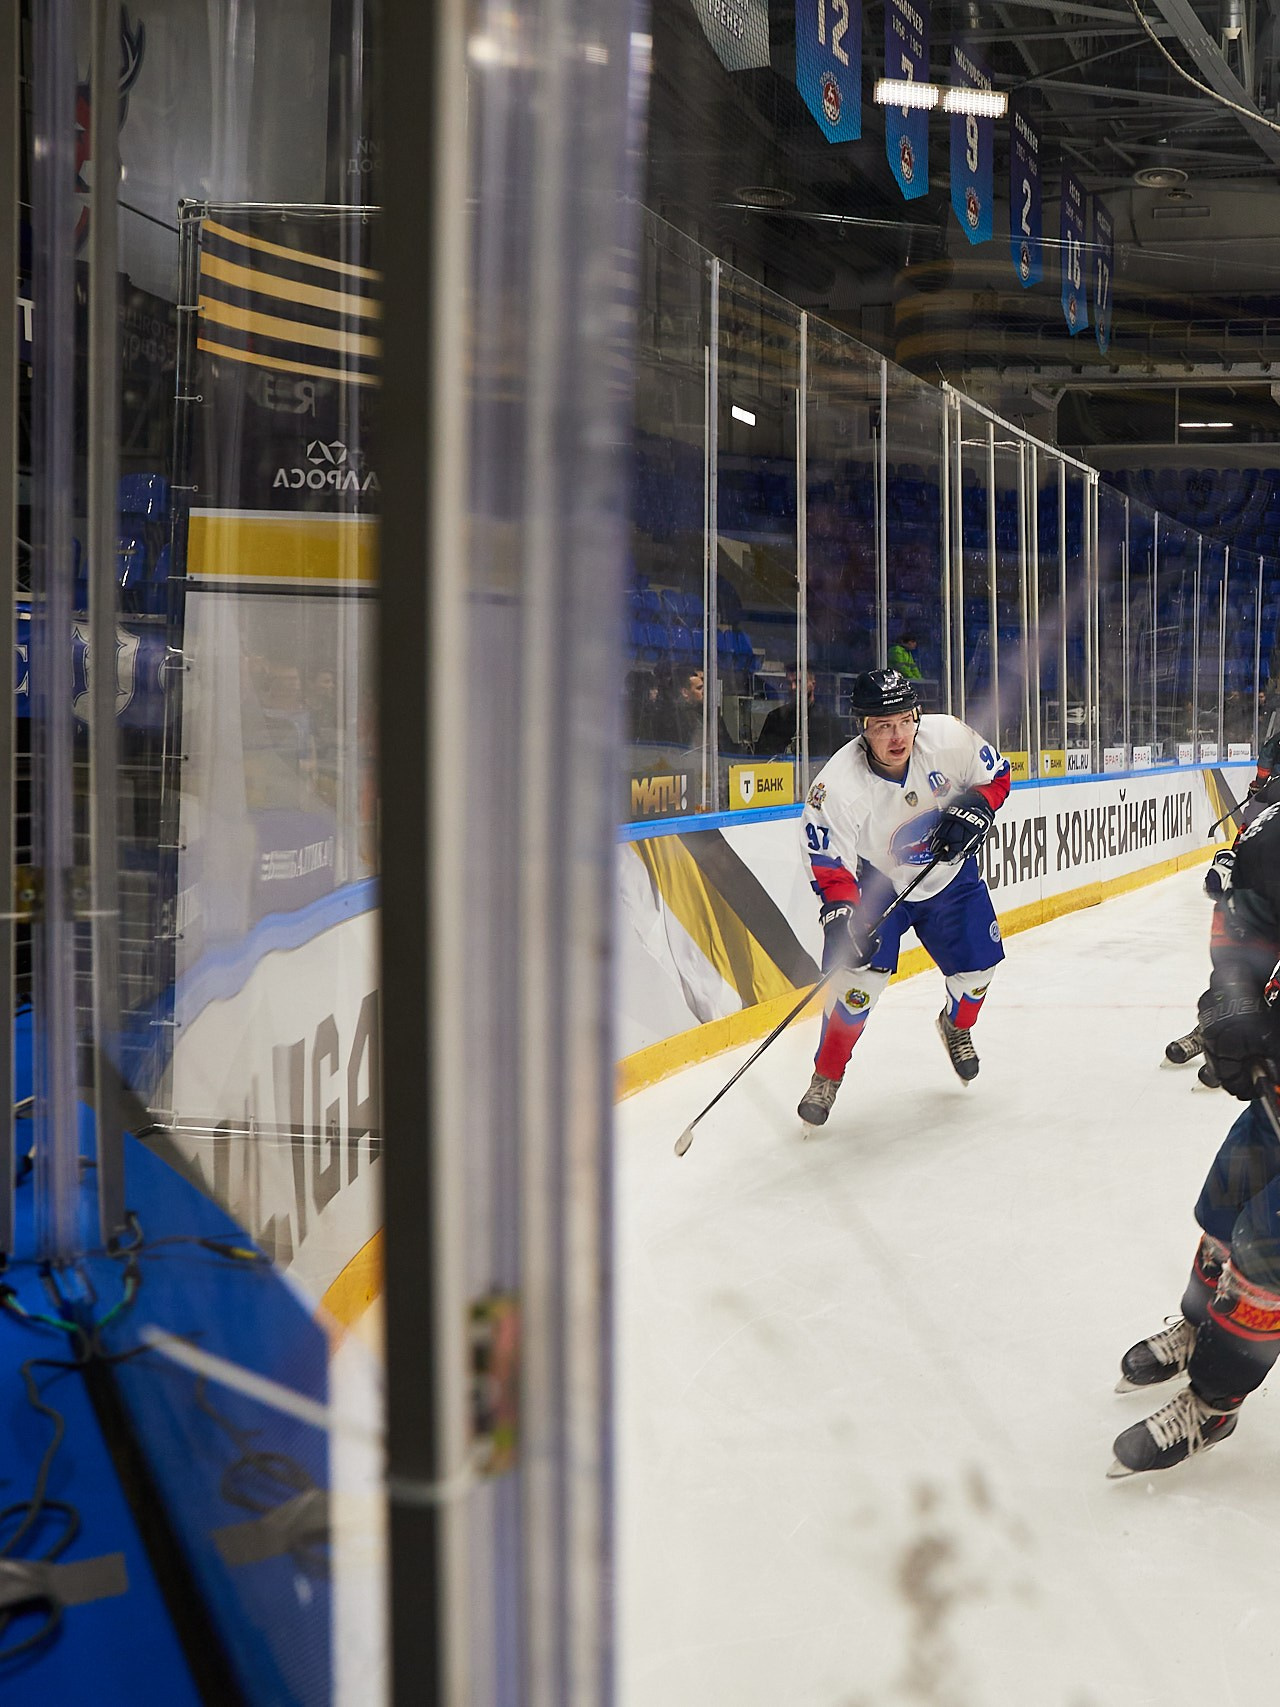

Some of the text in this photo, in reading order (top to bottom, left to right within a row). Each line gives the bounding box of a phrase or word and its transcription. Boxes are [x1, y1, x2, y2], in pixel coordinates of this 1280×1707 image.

[966, 114, 978, 173] 9
[1021, 178, 1031, 236] 2
[1067, 230, 1081, 290] 16
[1097, 257, 1109, 311] 17
[979, 745, 1001, 771] 9
[1011, 760, 1025, 772] БАНК
[1050, 759, 1063, 769] БАНК
[1067, 754, 1089, 771] KHL.RU
[743, 777, 784, 794] Т БАНК
[929, 773, 946, 788] 10
[631, 774, 688, 816] МАТЧ!
[805, 823, 830, 850] 97
[976, 788, 1193, 890] СКАЯ ХОККЕЙНАЯ ЛИГА
